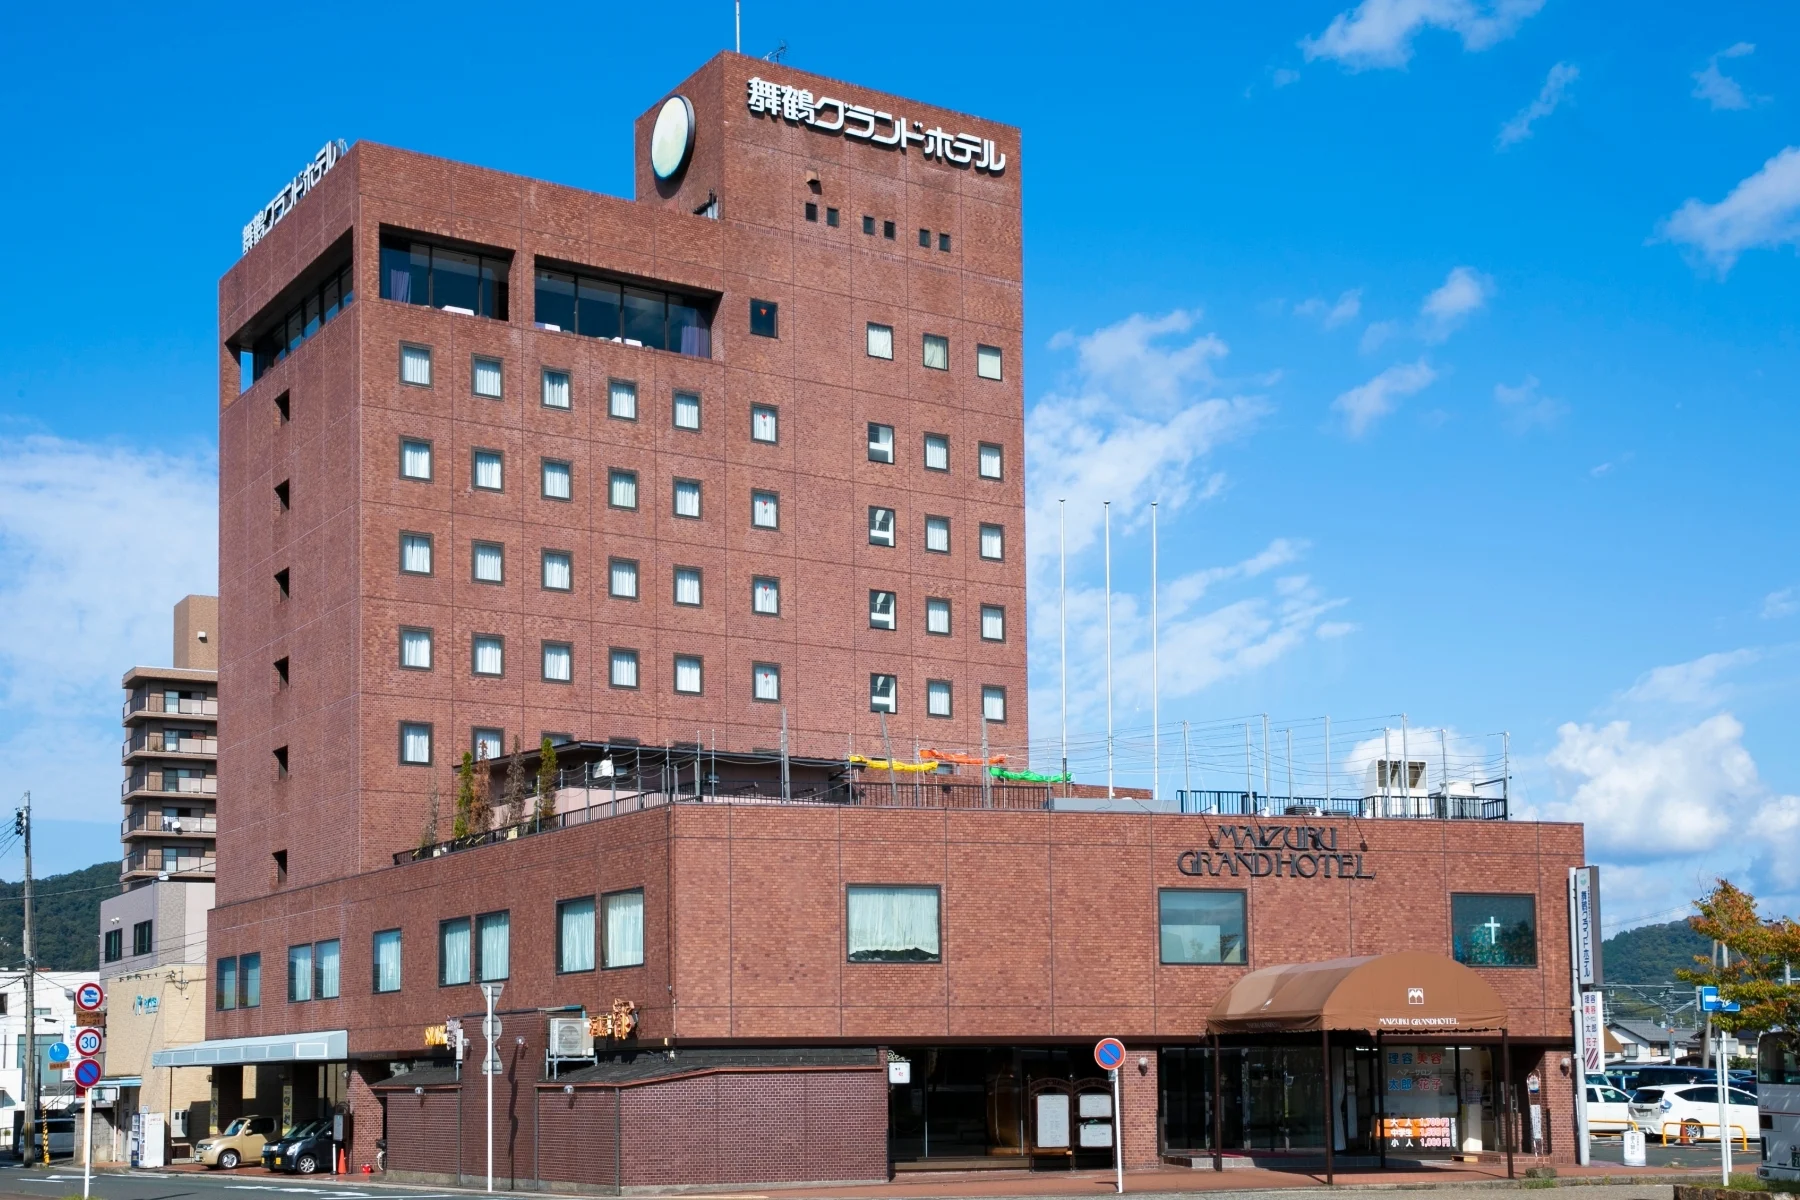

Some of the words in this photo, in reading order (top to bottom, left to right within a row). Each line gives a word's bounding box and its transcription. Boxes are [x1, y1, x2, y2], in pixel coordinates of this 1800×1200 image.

[747, 76, 1006, 171] 舞鶴グランドホテル
[81, 1036, 97, 1049] 30
